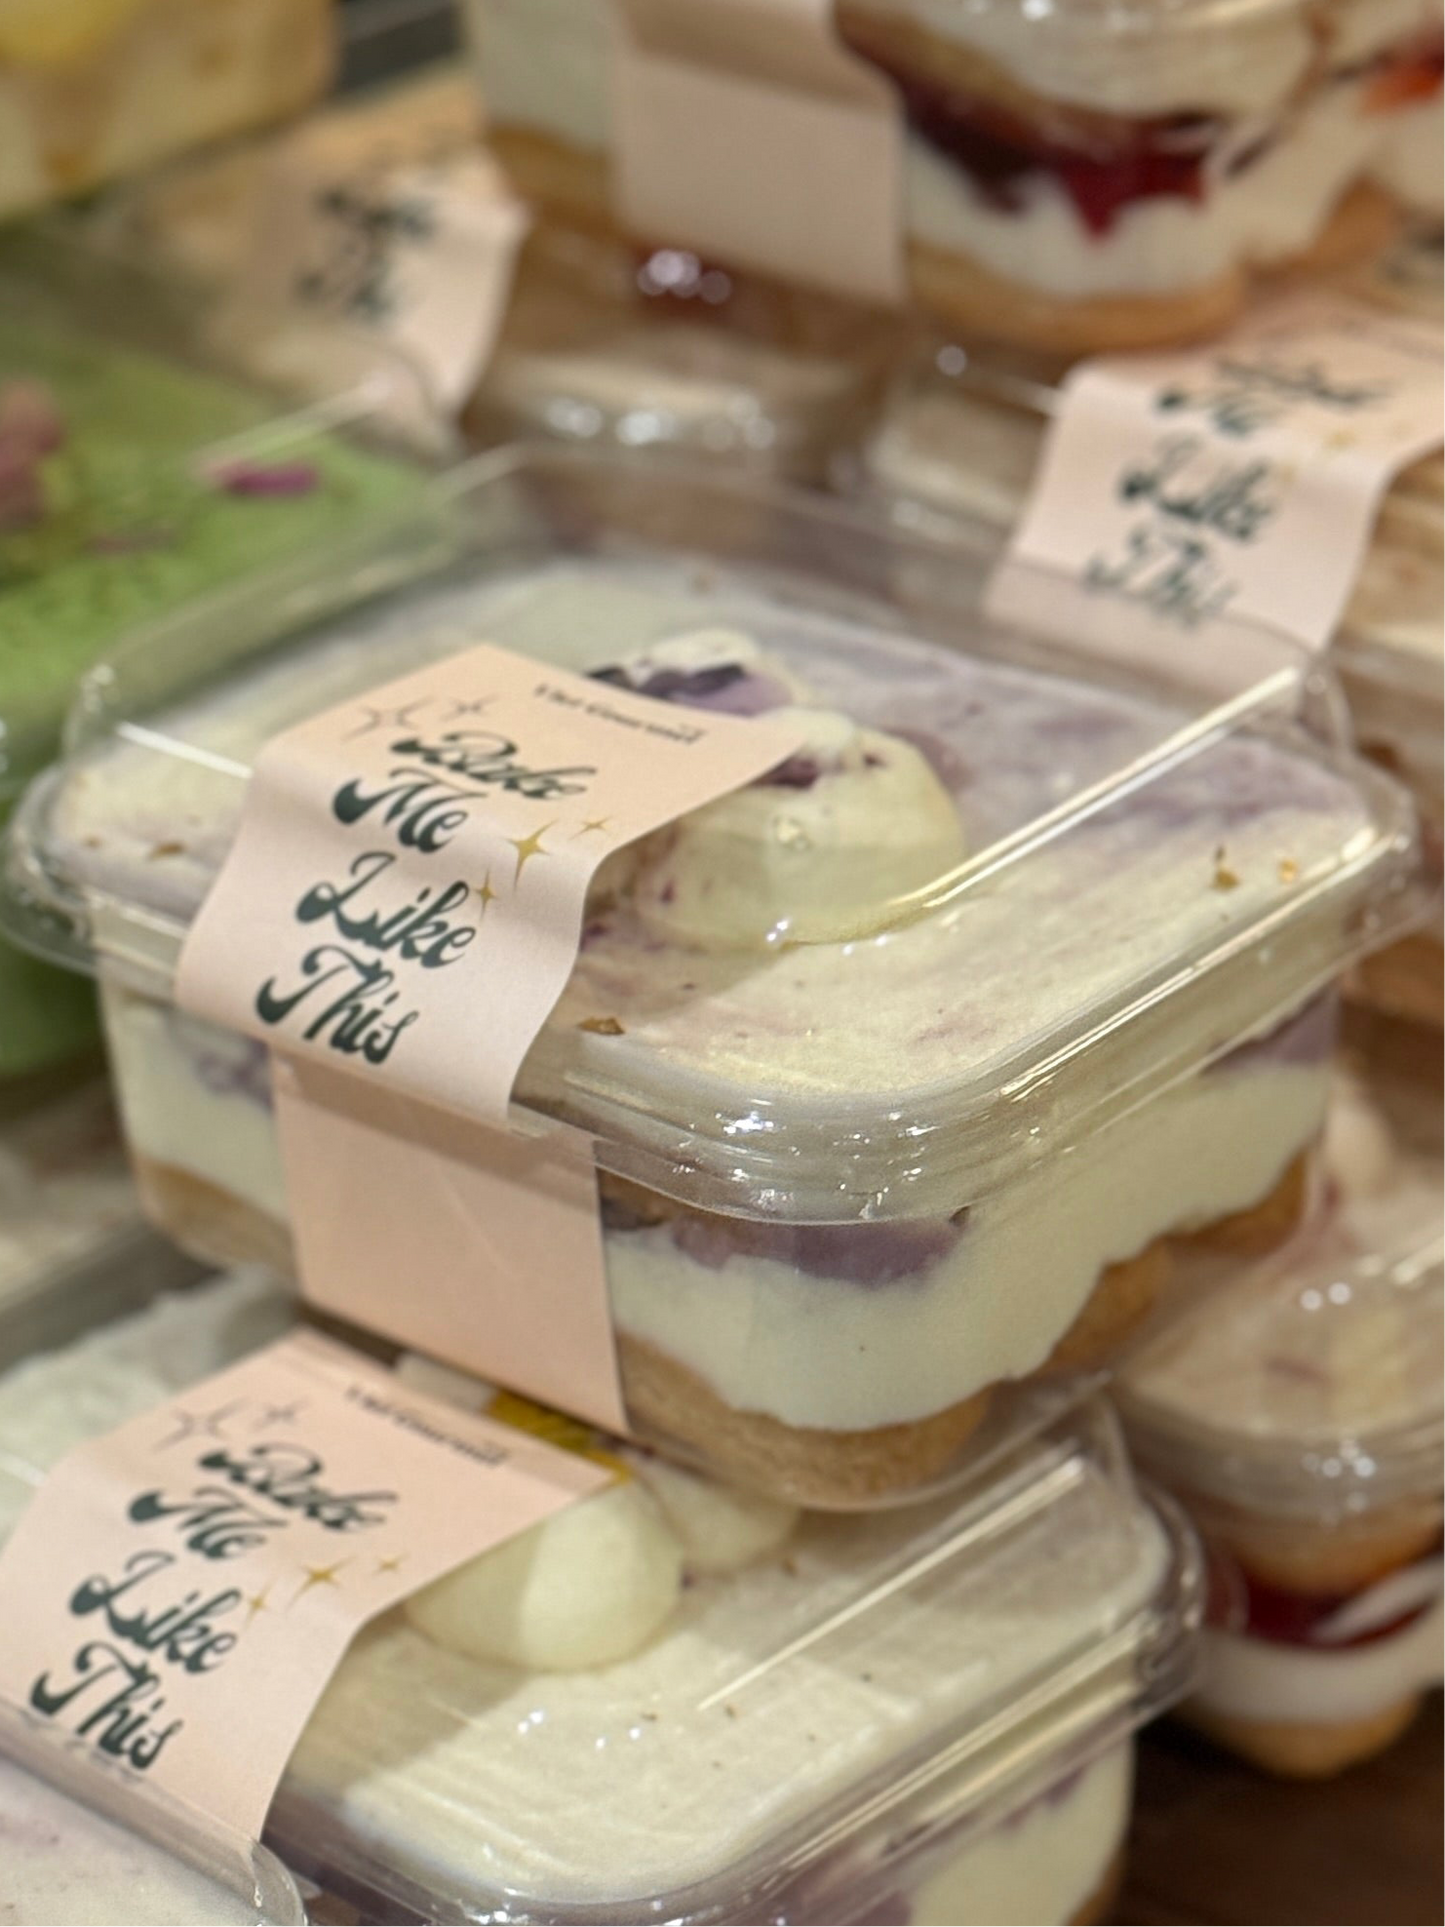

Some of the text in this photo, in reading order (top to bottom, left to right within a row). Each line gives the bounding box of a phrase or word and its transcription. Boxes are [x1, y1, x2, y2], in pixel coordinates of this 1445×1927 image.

[333, 767, 489, 854] Me
[296, 852, 477, 969] Like
[256, 945, 420, 1065] This
[128, 1485, 288, 1560] Me
[68, 1550, 242, 1674] Like
[30, 1641, 184, 1770] This
